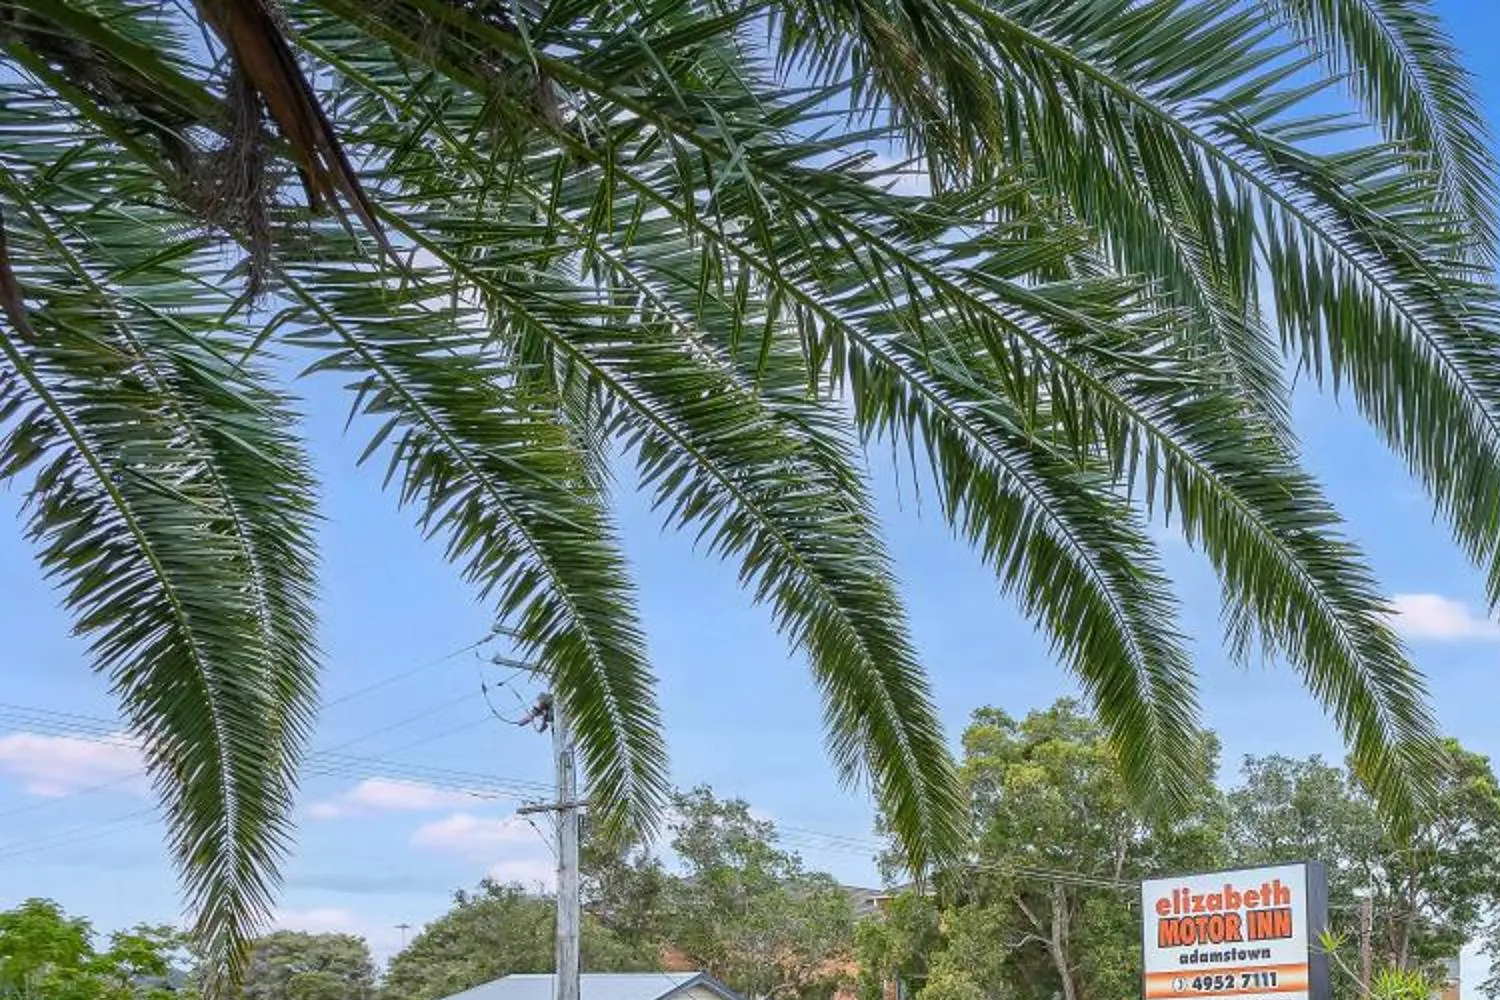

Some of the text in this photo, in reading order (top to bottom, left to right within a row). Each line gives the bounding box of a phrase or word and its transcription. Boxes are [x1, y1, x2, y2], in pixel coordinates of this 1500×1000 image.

[1156, 879, 1291, 916] elizabeth
[1158, 908, 1293, 949] MOTOR INN
[1179, 947, 1271, 965] adamstown
[1191, 971, 1277, 991] 4952 7111
